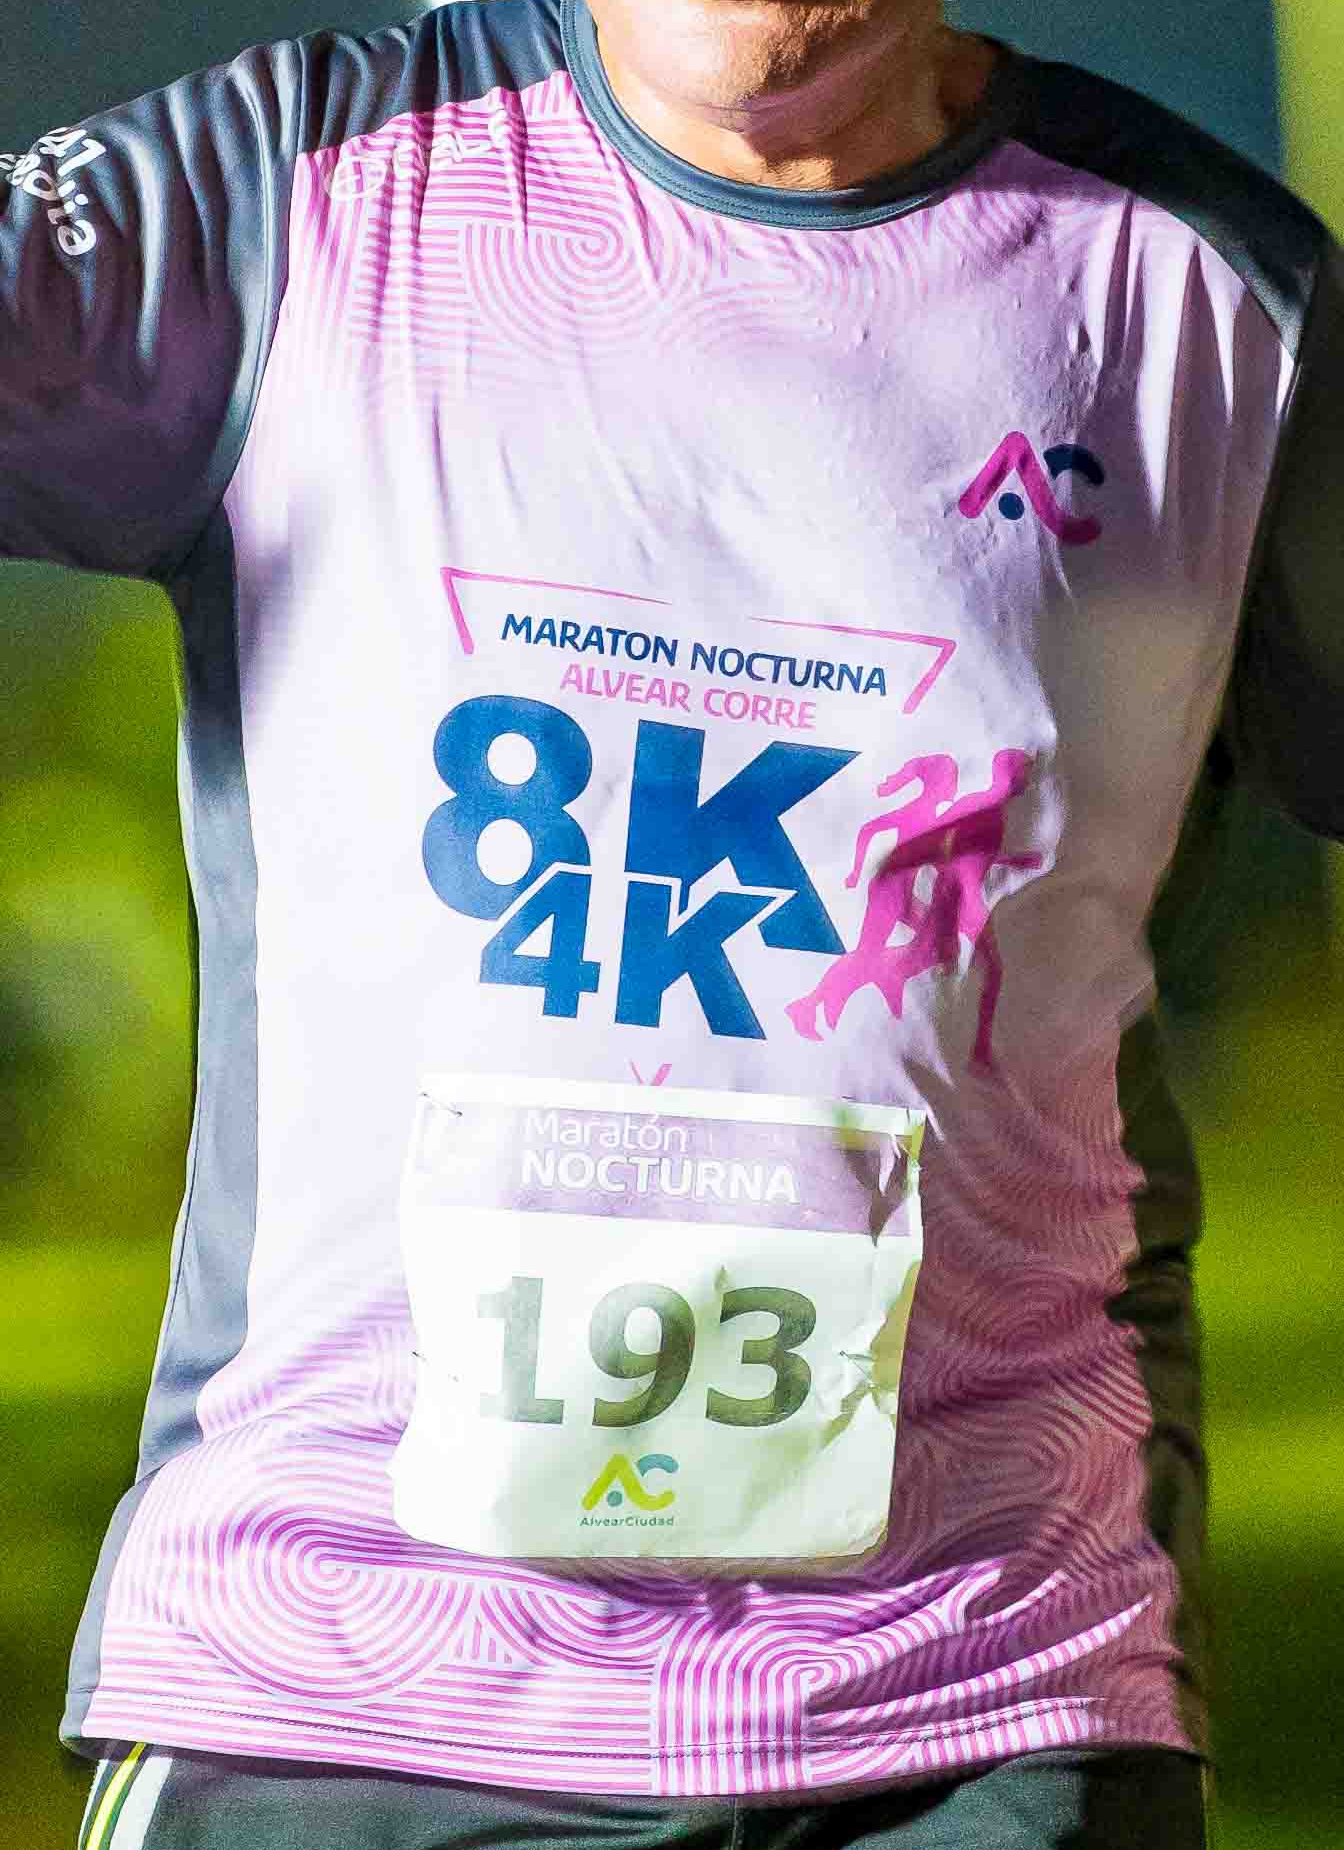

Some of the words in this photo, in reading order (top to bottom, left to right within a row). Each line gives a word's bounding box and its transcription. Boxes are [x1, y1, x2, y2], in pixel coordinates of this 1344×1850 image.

[501, 613, 678, 668] MARATON
[689, 641, 888, 697] NOCTURNA
[559, 663, 692, 713] ALVEAR
[703, 687, 817, 729] CORRE
[422, 695, 862, 955] 8K
[479, 870, 767, 1040] 4K
[523, 1111, 688, 1153] Maratón
[520, 1148, 801, 1203] NOCTURNA
[476, 1275, 817, 1428] 193
[579, 1516, 675, 1527] AlvearCiudad
